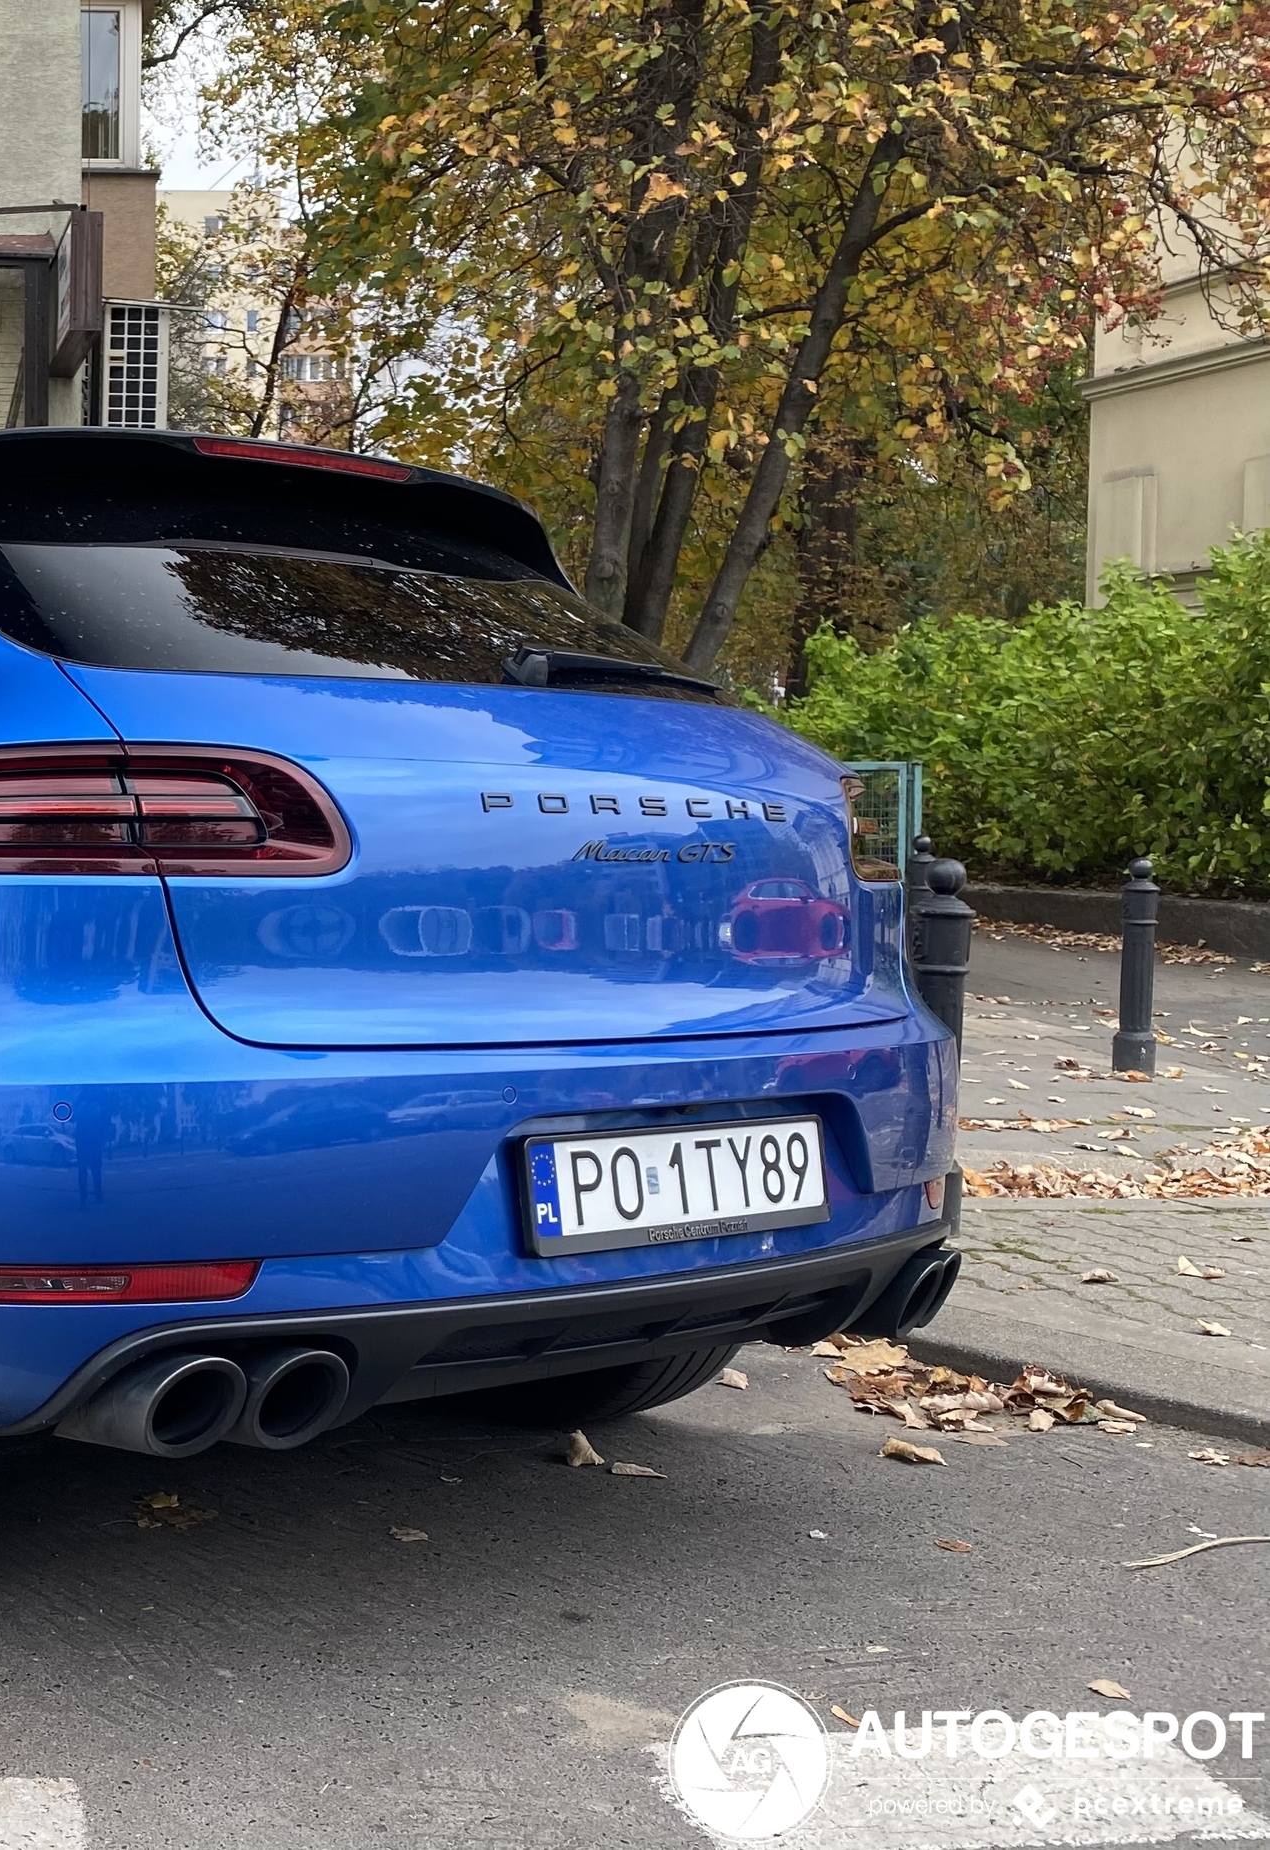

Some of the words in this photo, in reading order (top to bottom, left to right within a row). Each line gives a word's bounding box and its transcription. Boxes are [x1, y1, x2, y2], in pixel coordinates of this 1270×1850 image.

[480, 792, 787, 822] PORSCHE
[572, 840, 672, 863] Macan
[677, 842, 737, 864] GTS
[570, 1146, 645, 1227] PO
[668, 1131, 810, 1215] 1TY89
[536, 1203, 559, 1224] PL
[648, 1226, 684, 1242] Porsche
[683, 1222, 720, 1239] Centrum
